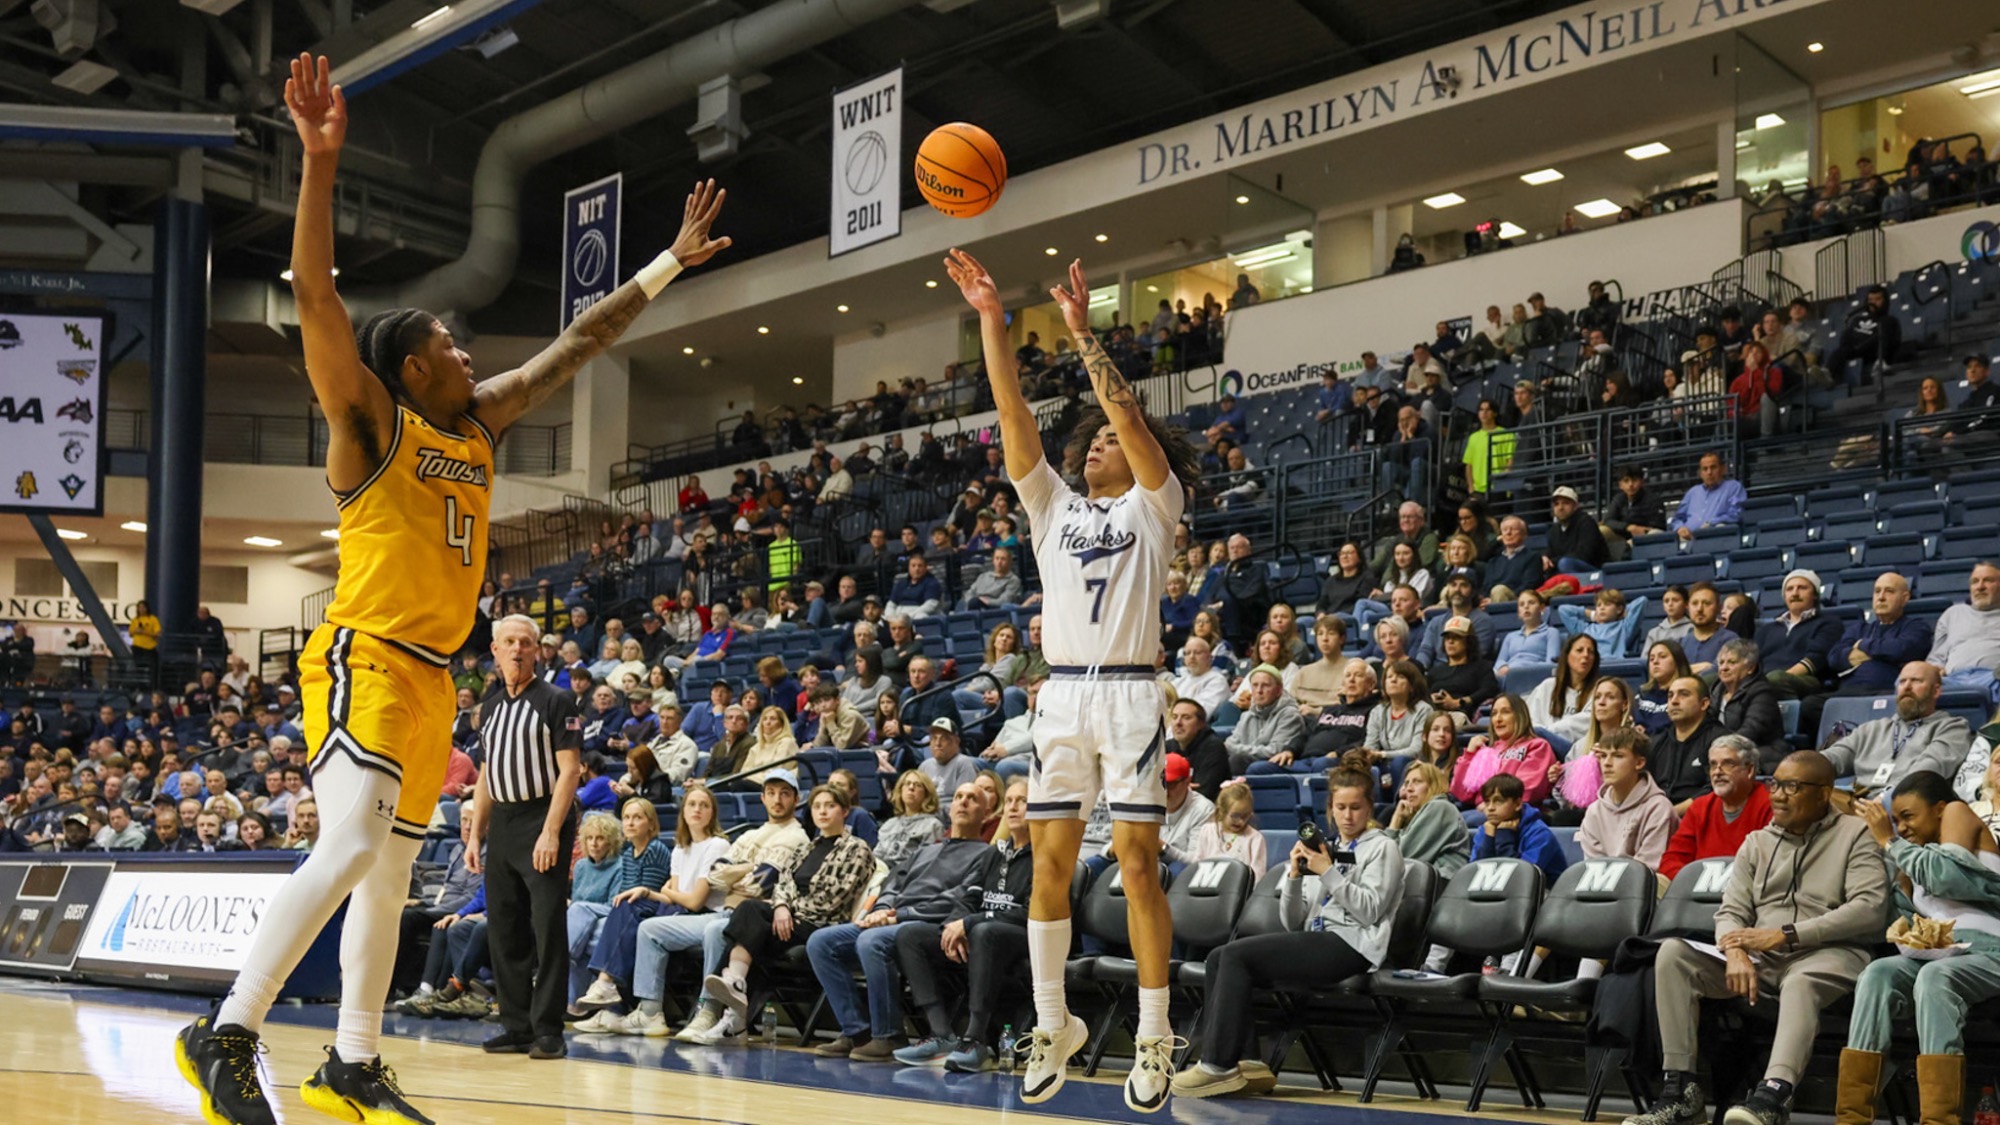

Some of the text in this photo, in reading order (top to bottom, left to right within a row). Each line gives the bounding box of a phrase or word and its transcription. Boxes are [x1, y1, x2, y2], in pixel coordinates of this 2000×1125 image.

[840, 84, 896, 130] WNIT
[1214, 80, 1400, 163] MARILYN
[917, 163, 965, 198] Wilson
[578, 193, 607, 226] NIT
[847, 201, 882, 236] 2011
[1340, 360, 1364, 374] BAN
[444, 496, 475, 566] 4
[1059, 523, 1132, 552] Hawks
[1085, 577, 1109, 625] 7
[1188, 861, 1231, 888] M
[1468, 861, 1519, 892] M
[1575, 861, 1629, 892] M
